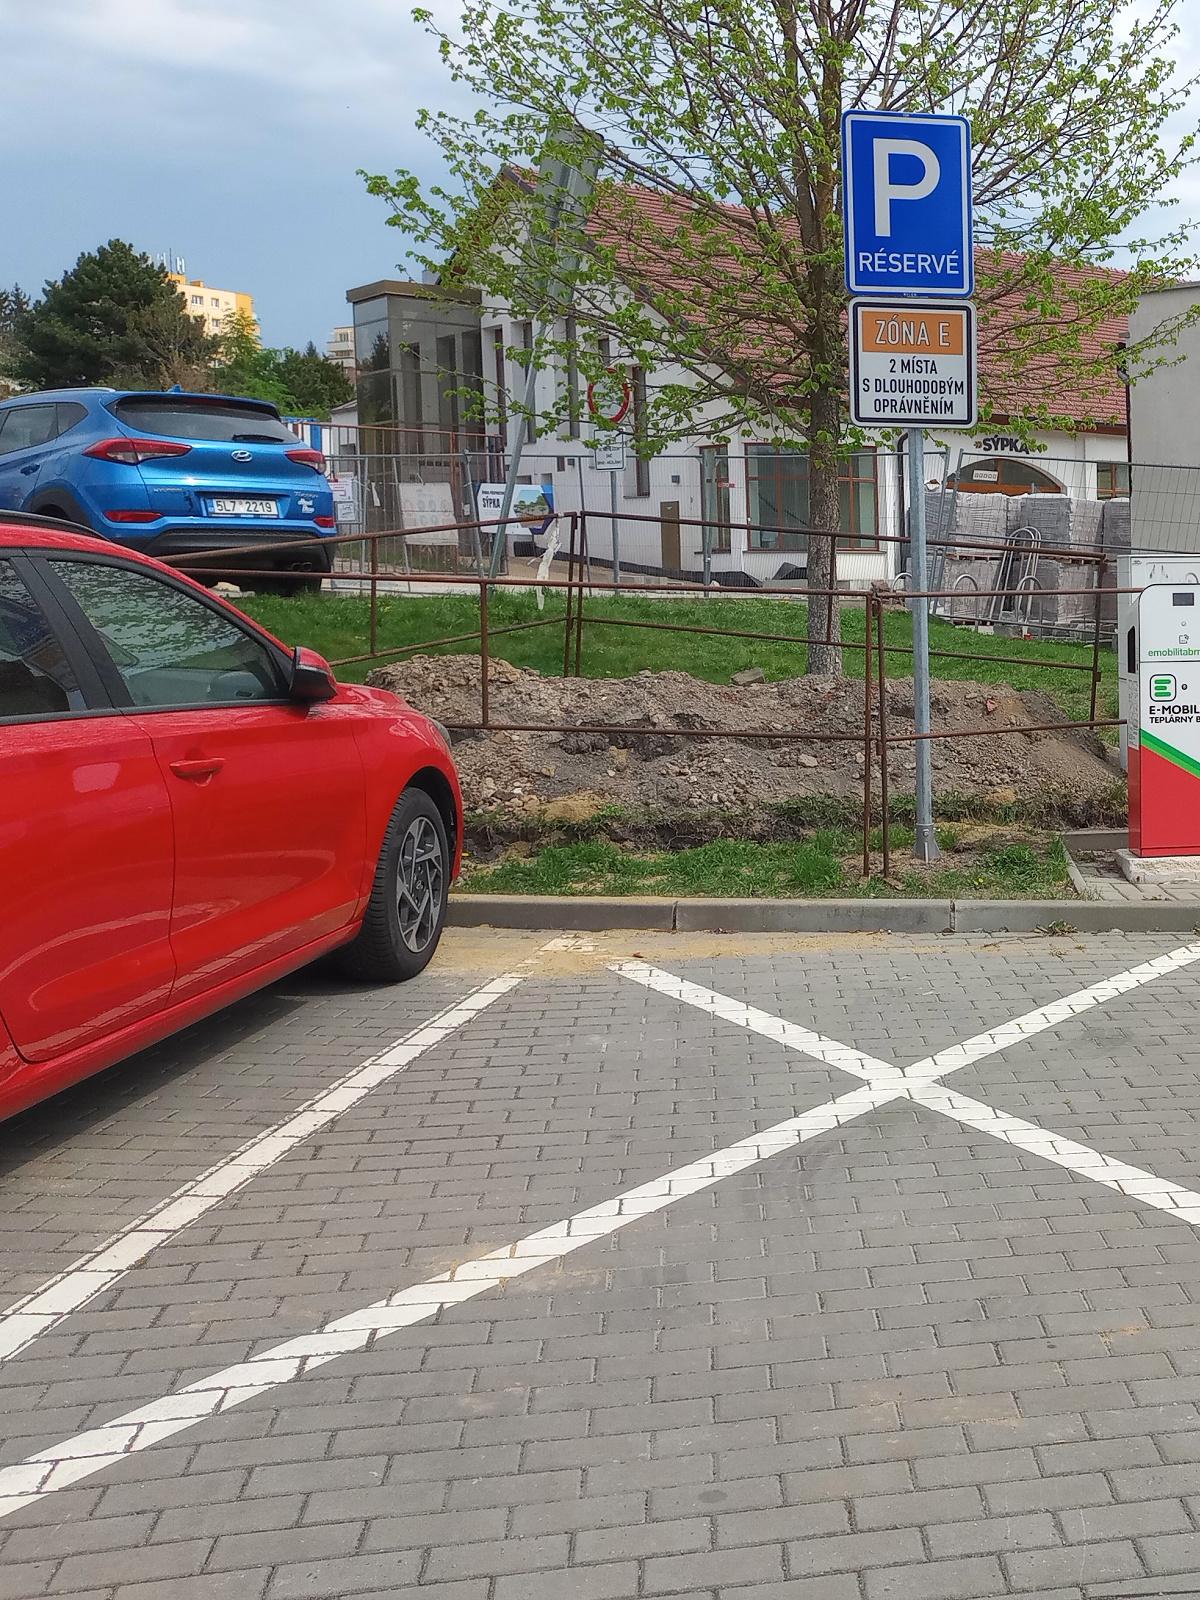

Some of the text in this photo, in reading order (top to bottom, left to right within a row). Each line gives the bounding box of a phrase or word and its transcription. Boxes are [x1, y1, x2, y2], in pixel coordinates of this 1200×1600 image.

[873, 137, 941, 237] P
[858, 248, 960, 275] RÉSERVÉ
[875, 313, 951, 348] ZÓNA E
[889, 355, 938, 375] 2 MÍSTA
[862, 376, 964, 396] S DLOUHODOBÝM
[873, 395, 954, 415] OPRÁVNĚNÍM
[982, 434, 1030, 454] SÝPKA
[215, 498, 272, 513] 5L7 2219
[1150, 714, 1193, 724] TEPLÁRNY
